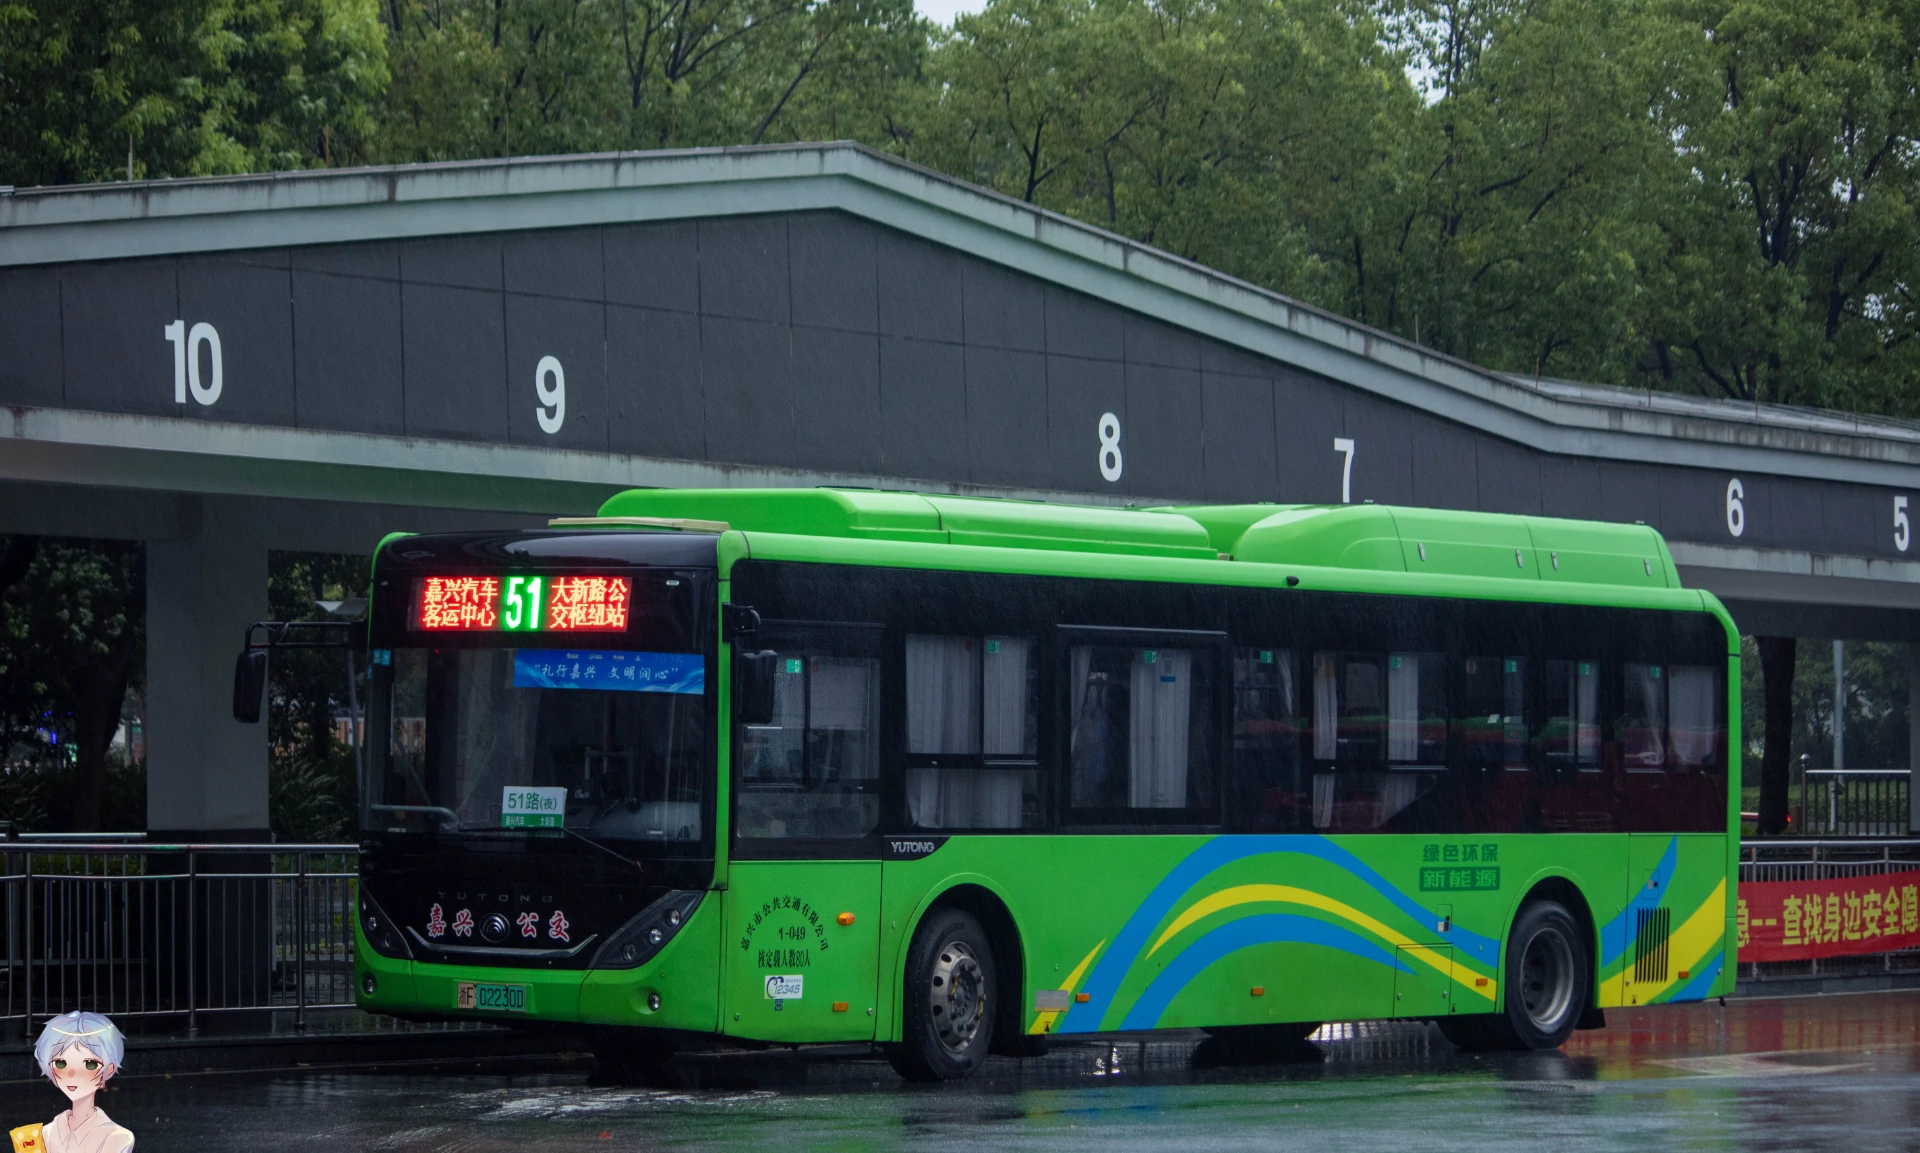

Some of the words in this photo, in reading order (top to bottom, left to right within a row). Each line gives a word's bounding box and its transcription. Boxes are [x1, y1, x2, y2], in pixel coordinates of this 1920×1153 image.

[165, 319, 223, 405] 10
[535, 355, 566, 434] 9
[1098, 412, 1123, 482] 8
[1333, 437, 1355, 503] 7
[1726, 478, 1745, 537] 6
[1893, 495, 1910, 552] 5
[424, 577, 498, 603] 嘉兴汽车
[505, 577, 542, 629] 51
[551, 577, 628, 603] 大新路公
[423, 603, 496, 627] 客运中心
[549, 603, 626, 629] 交枢纽站
[891, 841, 935, 853] YUTONG
[1422, 843, 1498, 862] 绿色环保
[1423, 869, 1497, 888] 新能源
[438, 891, 553, 903] YUTONG
[427, 903, 475, 938] 嘉兴
[516, 909, 570, 942] 公交
[778, 926, 806, 941] 1-049
[774, 984, 801, 995] 12345
